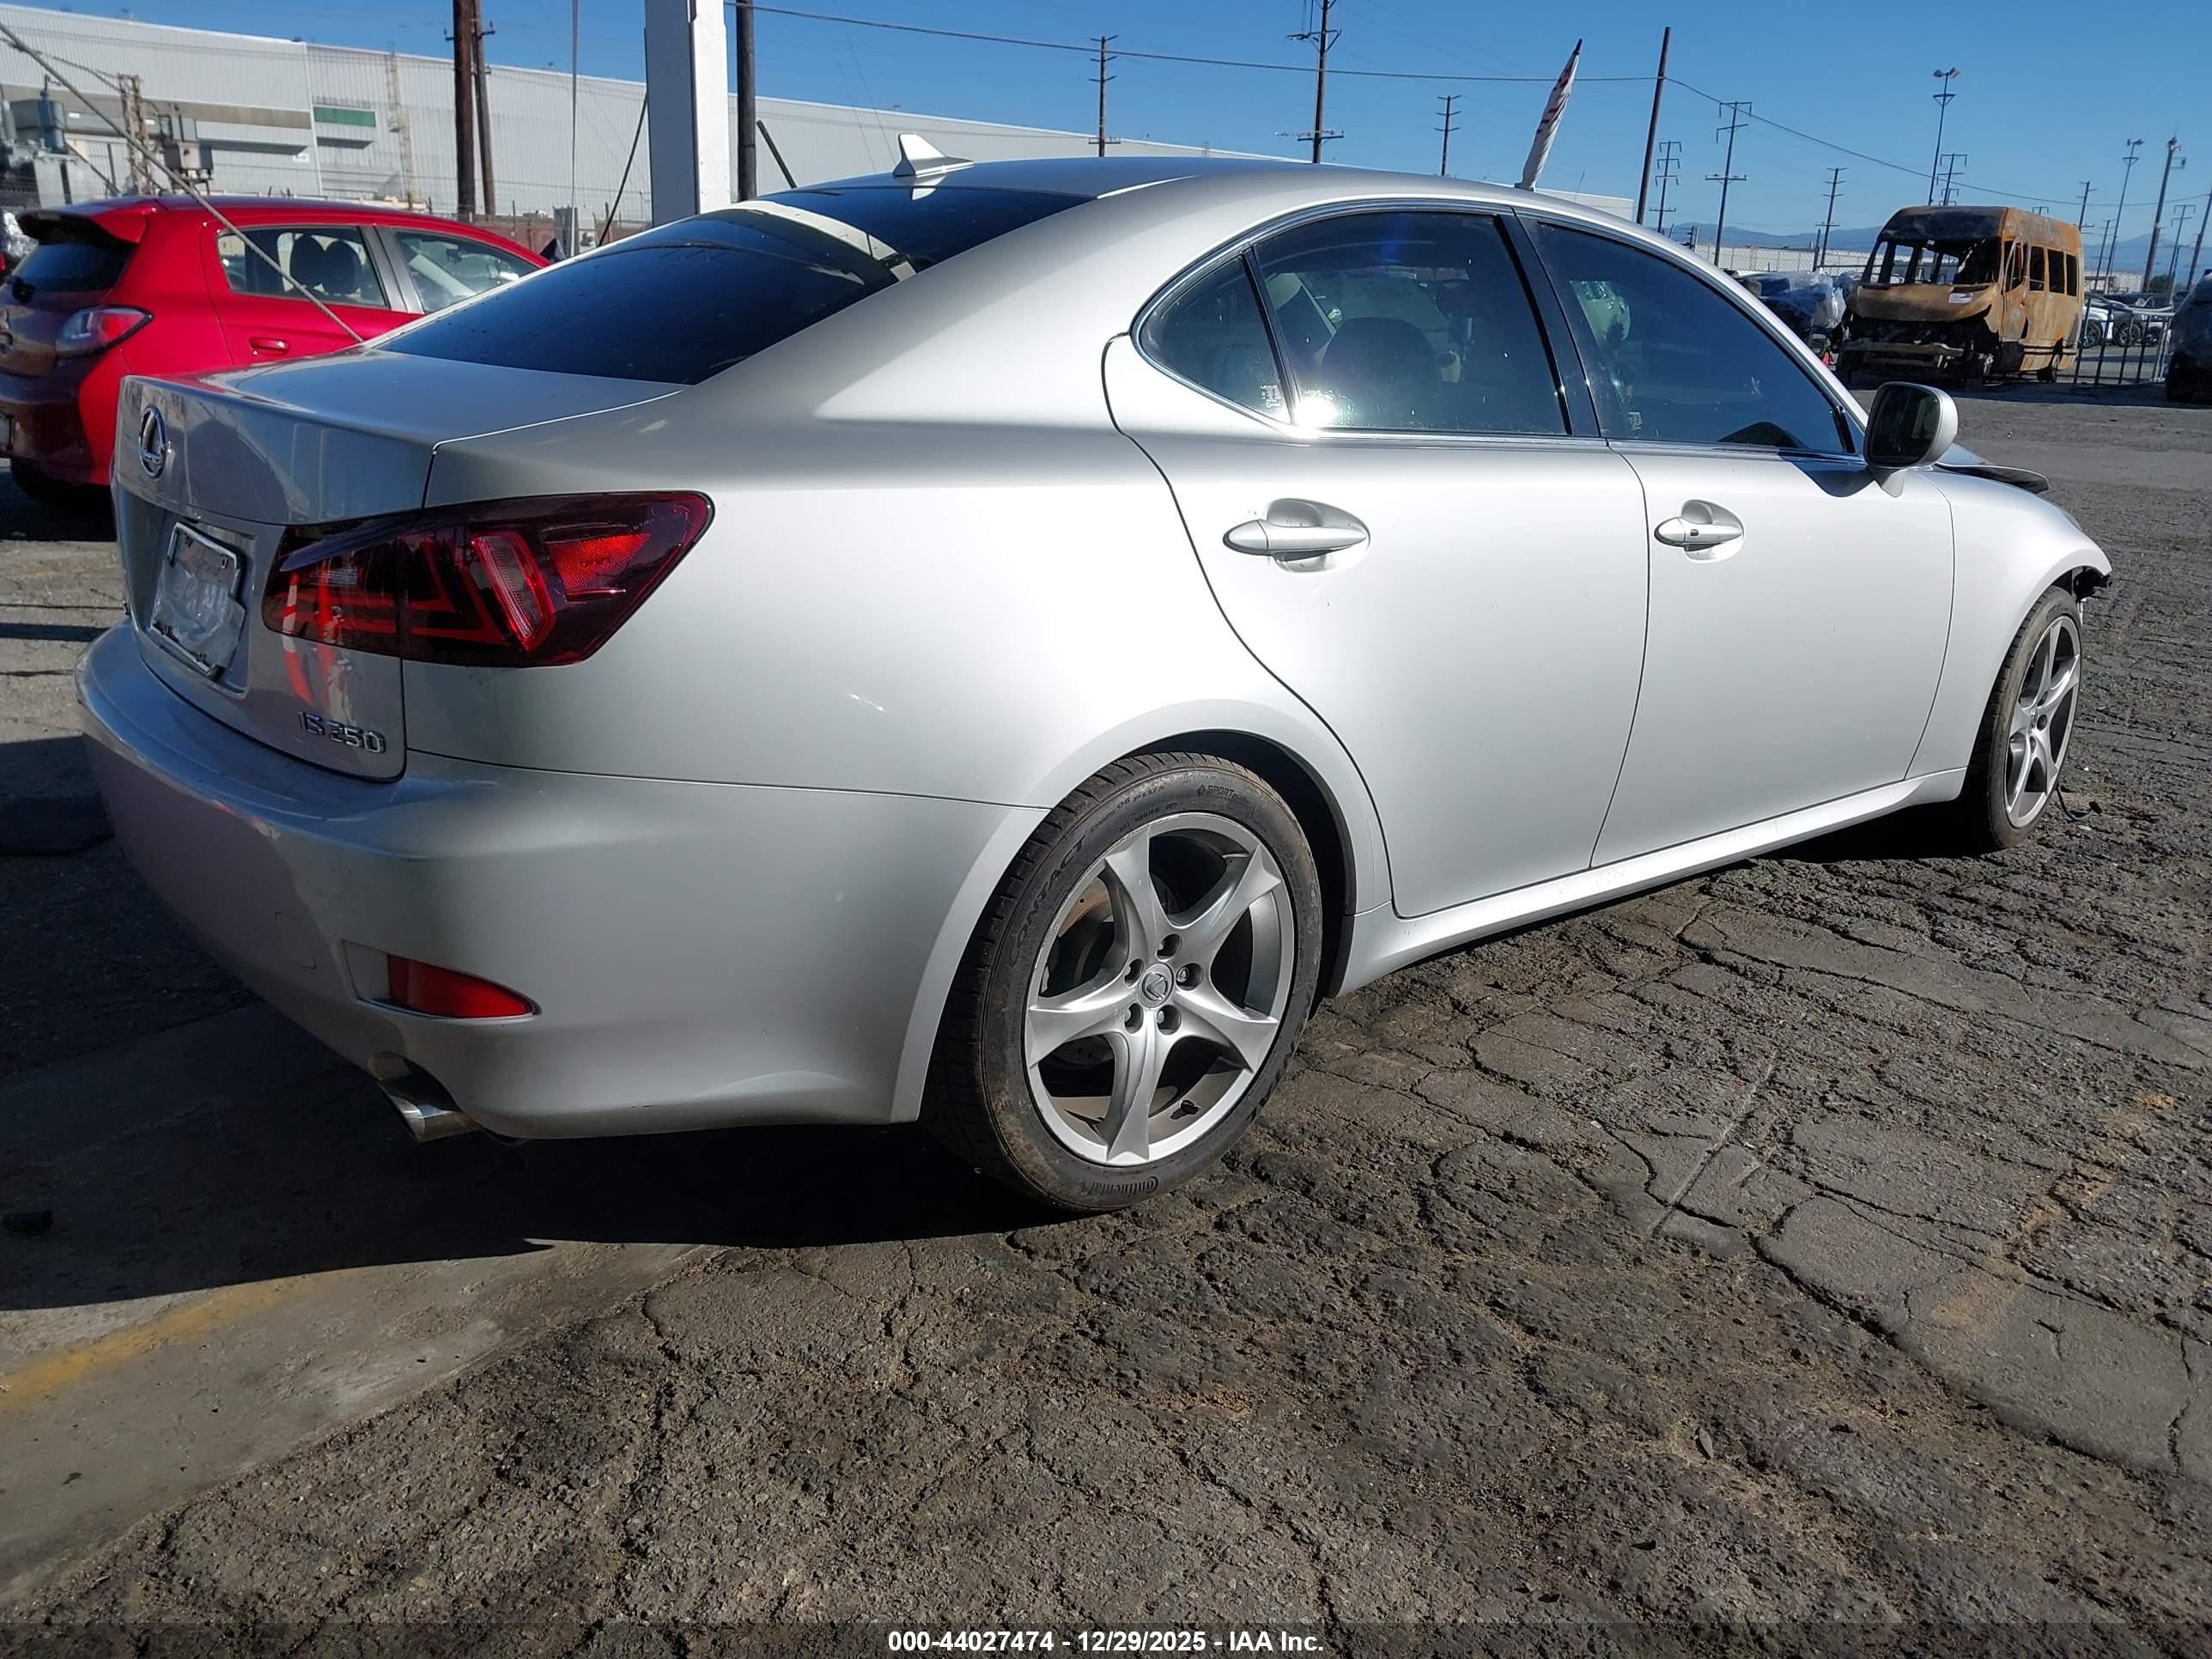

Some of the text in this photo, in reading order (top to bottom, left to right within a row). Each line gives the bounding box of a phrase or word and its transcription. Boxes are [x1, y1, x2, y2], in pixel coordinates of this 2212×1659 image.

[296, 710, 387, 754] IS 250
[1133, 785, 1166, 803] PLUS
[1086, 1176, 1159, 1196] Continental
